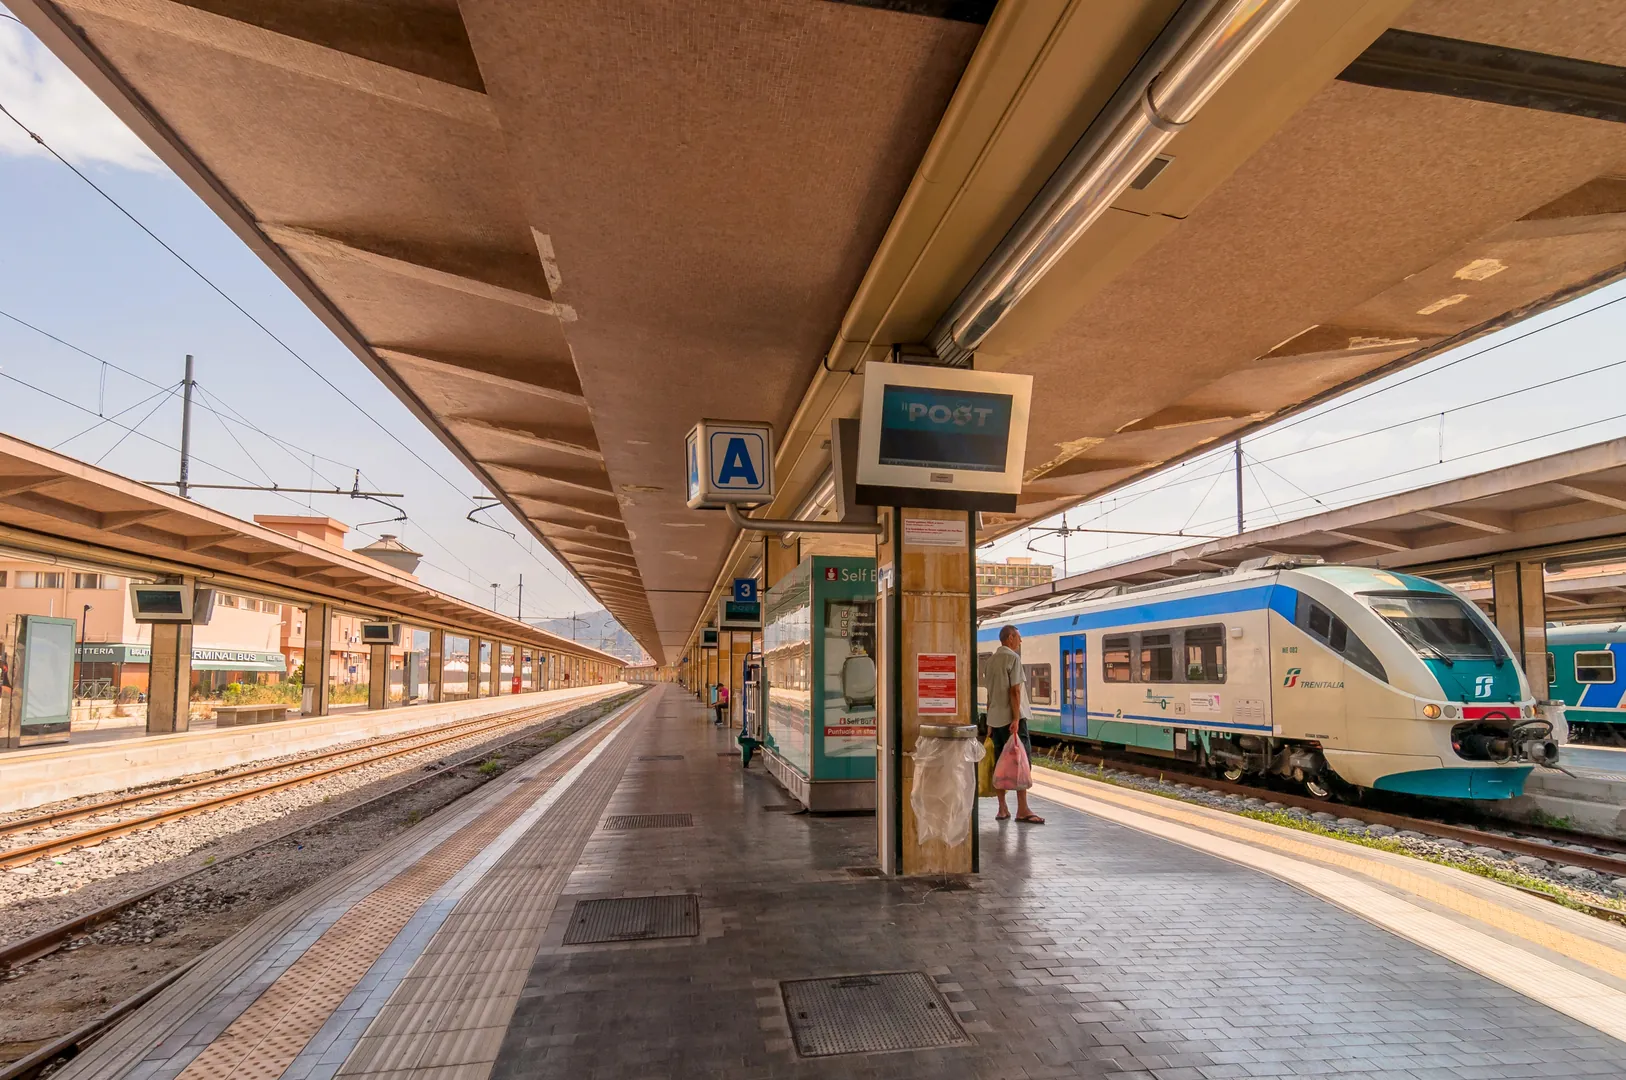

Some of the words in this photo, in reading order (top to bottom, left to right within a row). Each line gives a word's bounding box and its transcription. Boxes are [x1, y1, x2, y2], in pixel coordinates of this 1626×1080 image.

[717, 437, 759, 485] A
[841, 568, 867, 582] Self
[740, 583, 751, 597] 3
[192, 650, 235, 660] RMINAL
[237, 653, 257, 661] BUS
[1300, 681, 1345, 689] TRENITALIA
[1115, 708, 1122, 719] 2
[846, 717, 858, 725] Self
[860, 717, 872, 725] Bar
